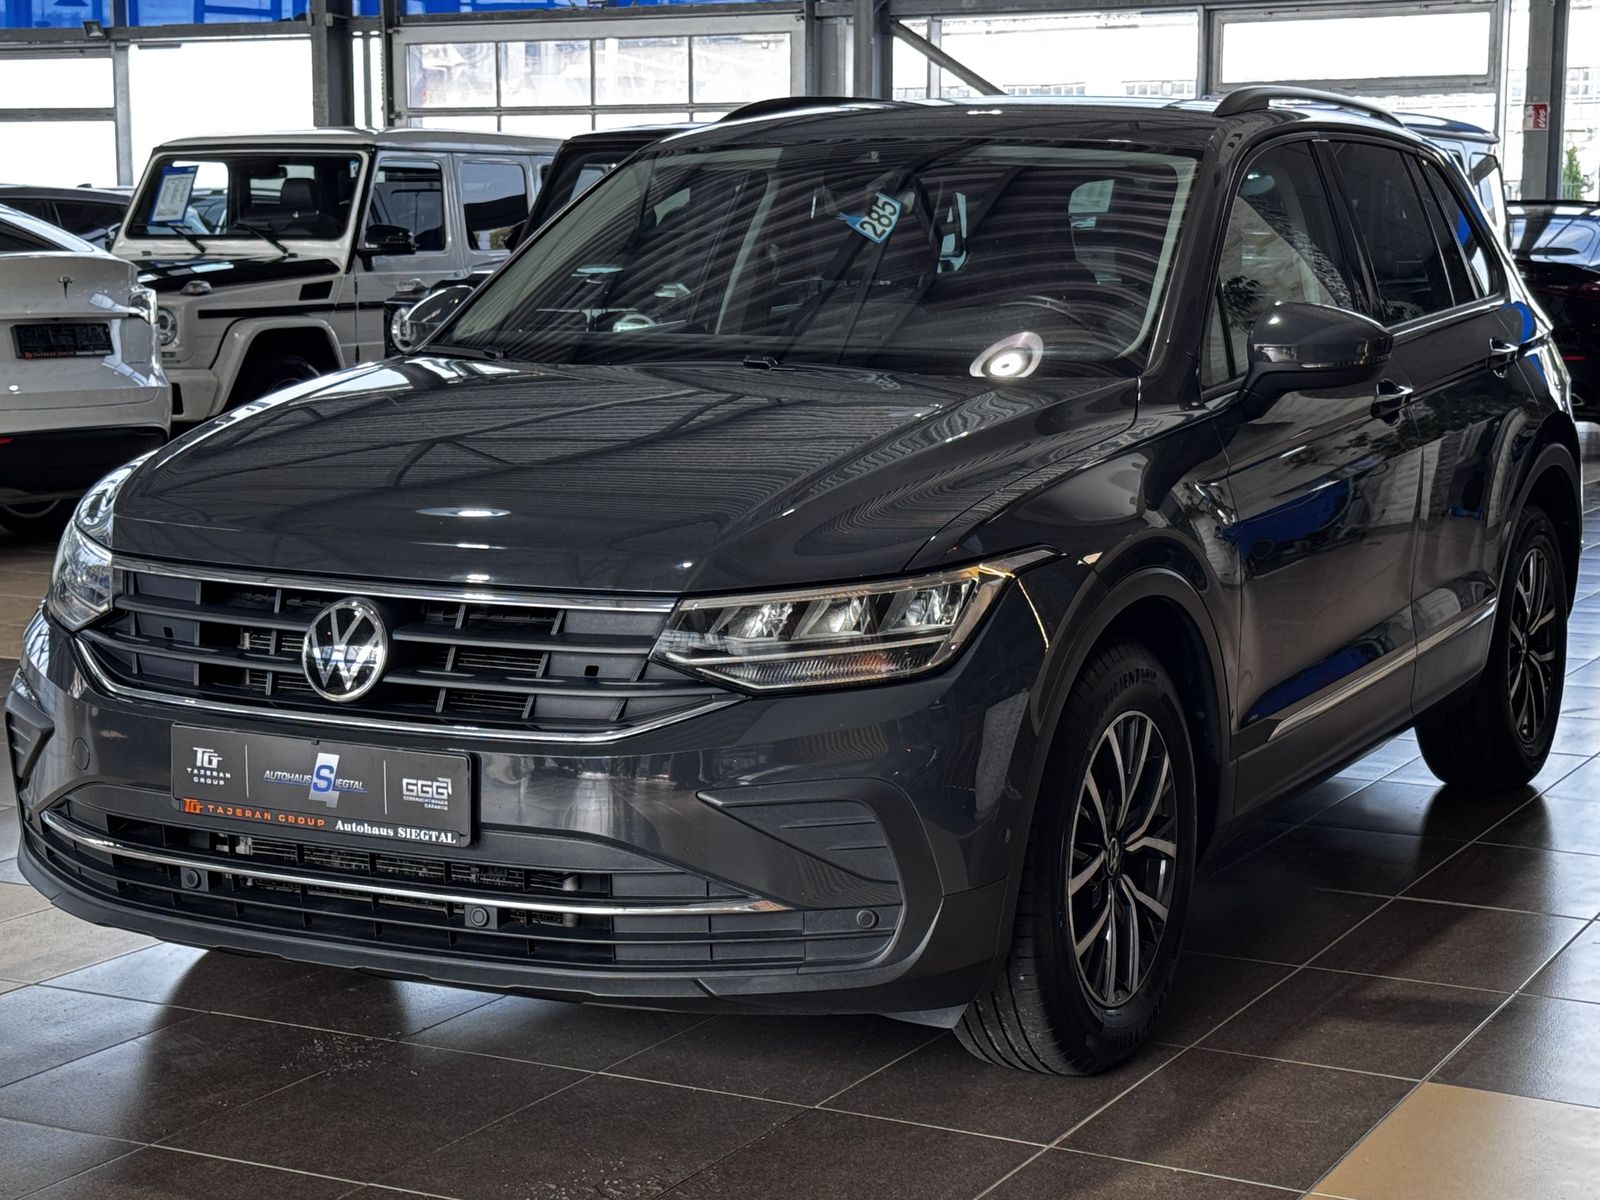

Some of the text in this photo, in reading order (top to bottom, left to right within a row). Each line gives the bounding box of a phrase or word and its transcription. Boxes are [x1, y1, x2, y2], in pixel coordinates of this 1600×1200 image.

[859, 200, 898, 239] 285
[192, 747, 223, 768] TG
[186, 768, 231, 779] TAJERAN
[193, 776, 225, 786] GROUP
[264, 770, 312, 785] AUTOHAUS
[402, 778, 448, 800] GGG
[207, 804, 271, 820] TAJERAN
[278, 814, 325, 827] GROUP
[335, 819, 394, 837] Autohaus
[397, 826, 457, 844] SIEGTAL
